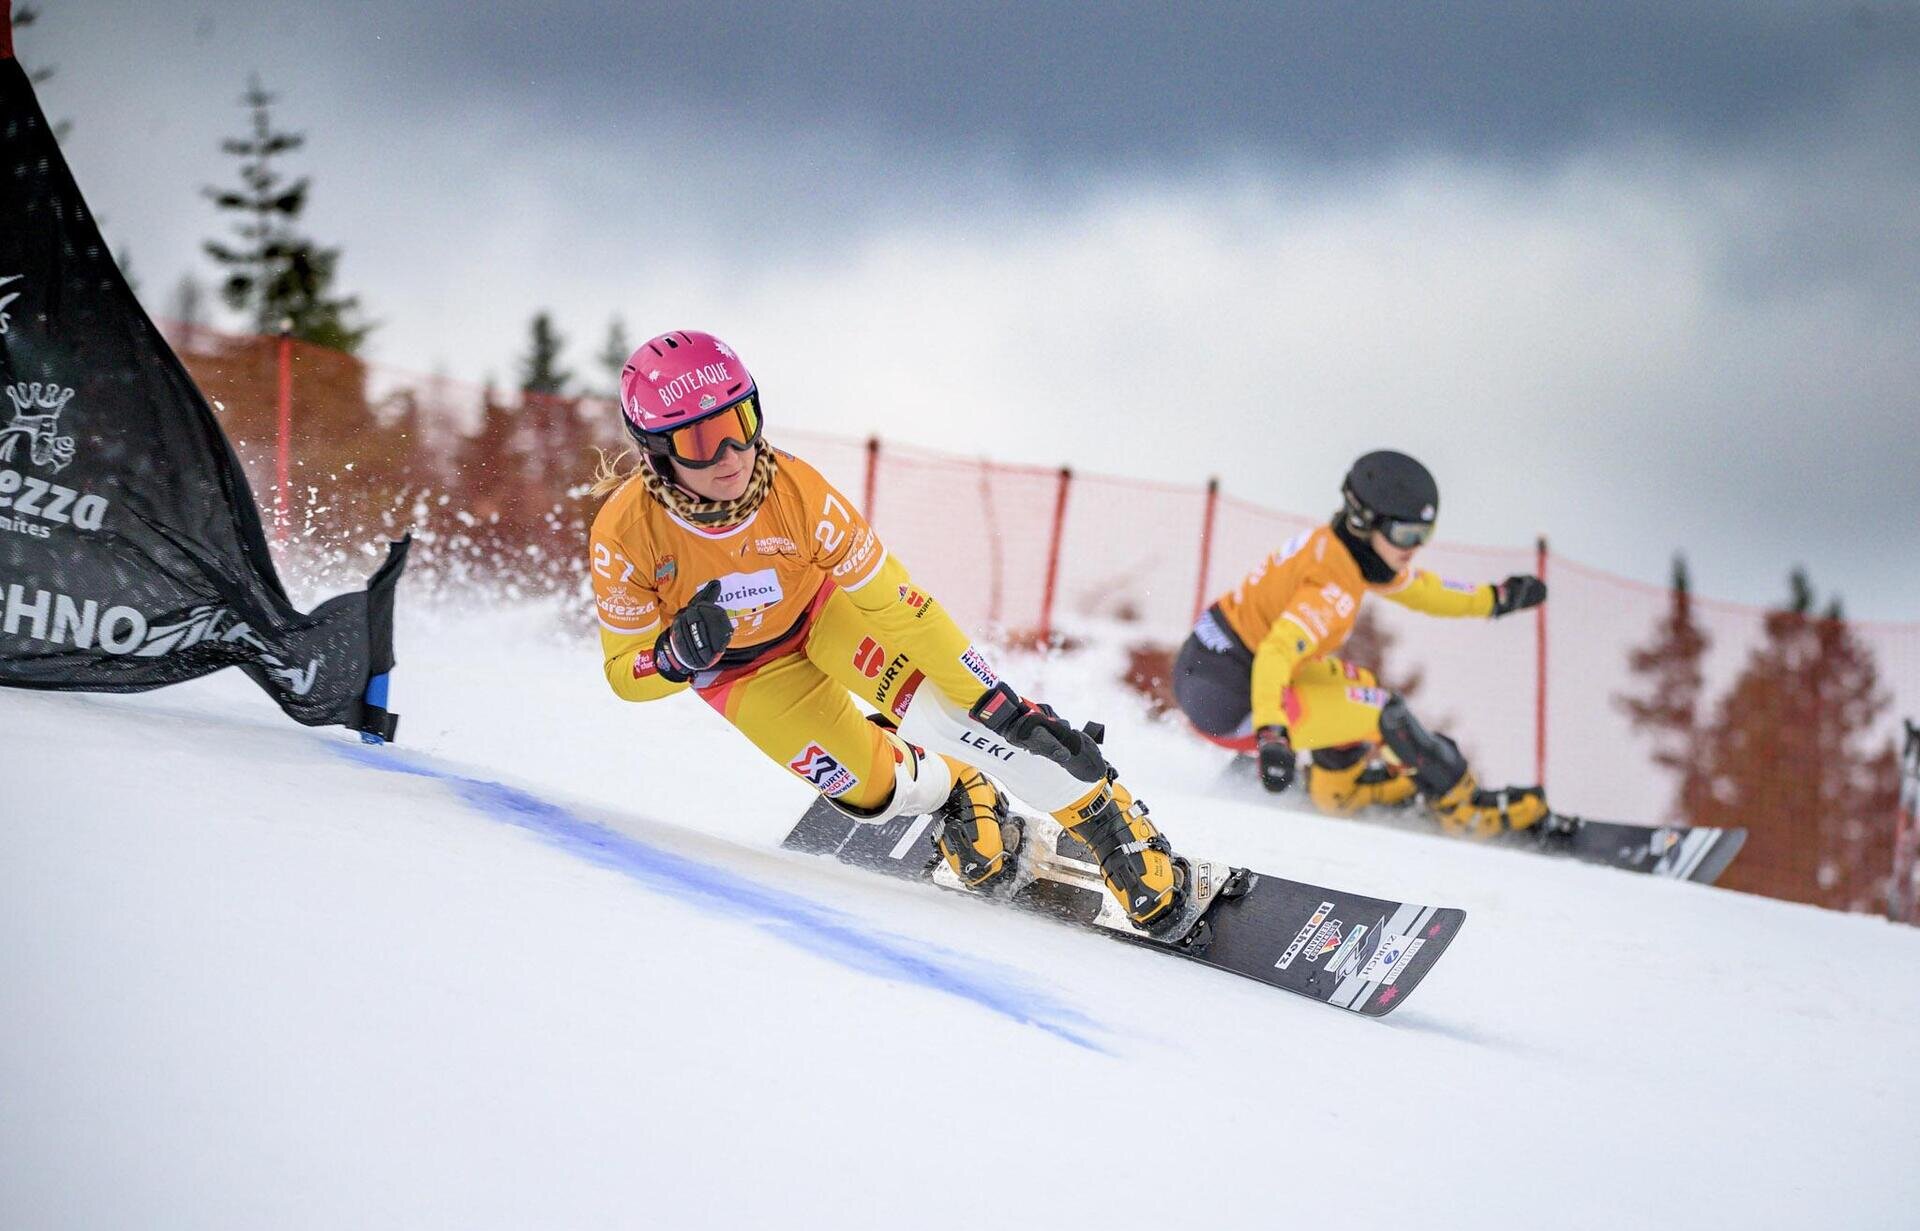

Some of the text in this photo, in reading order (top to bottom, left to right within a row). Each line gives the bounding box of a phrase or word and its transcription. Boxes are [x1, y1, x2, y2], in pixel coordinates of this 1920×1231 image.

[658, 362, 732, 407] BIOTEAQUE
[814, 492, 850, 553] 27
[594, 543, 634, 582] 27
[960, 731, 1016, 762] LEKI
